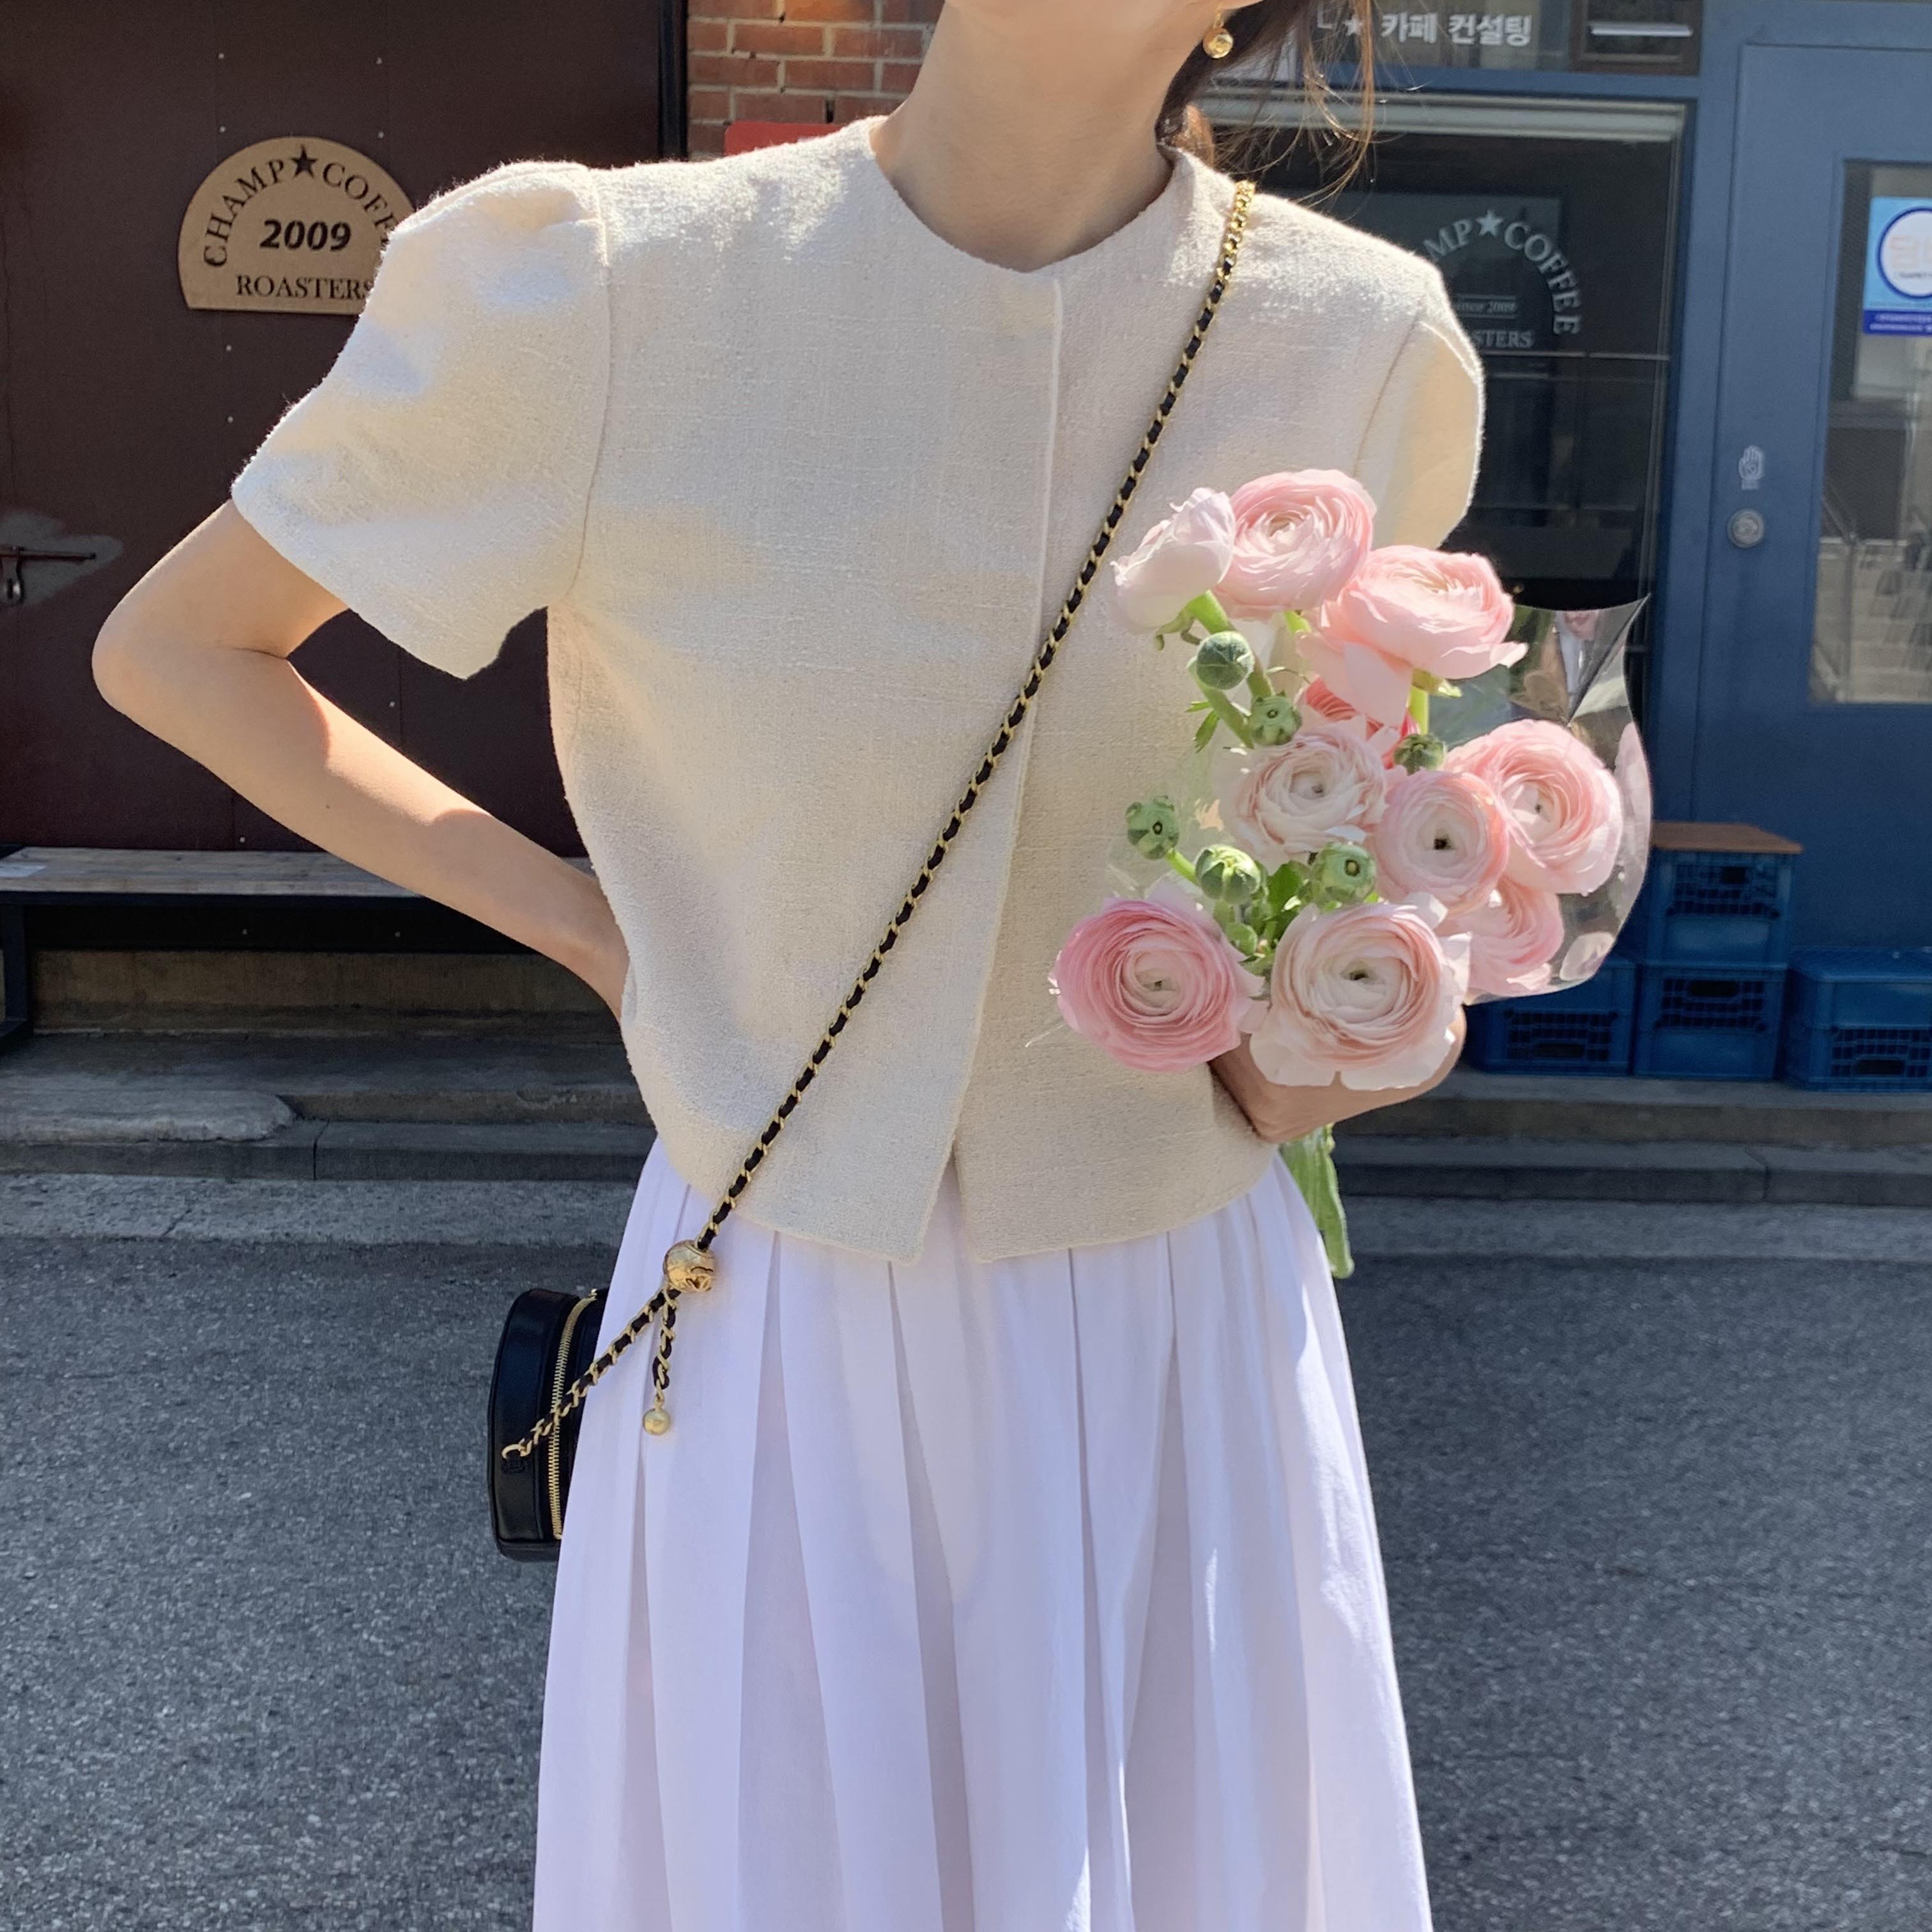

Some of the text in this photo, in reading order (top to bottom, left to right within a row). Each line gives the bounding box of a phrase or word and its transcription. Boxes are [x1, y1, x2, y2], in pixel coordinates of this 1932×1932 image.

[1381, 12, 1532, 46] 카페 컨설팅
[203, 158, 401, 266] CHAMP COFF
[259, 219, 351, 251] 2009
[1504, 221, 1582, 335] COFFEE
